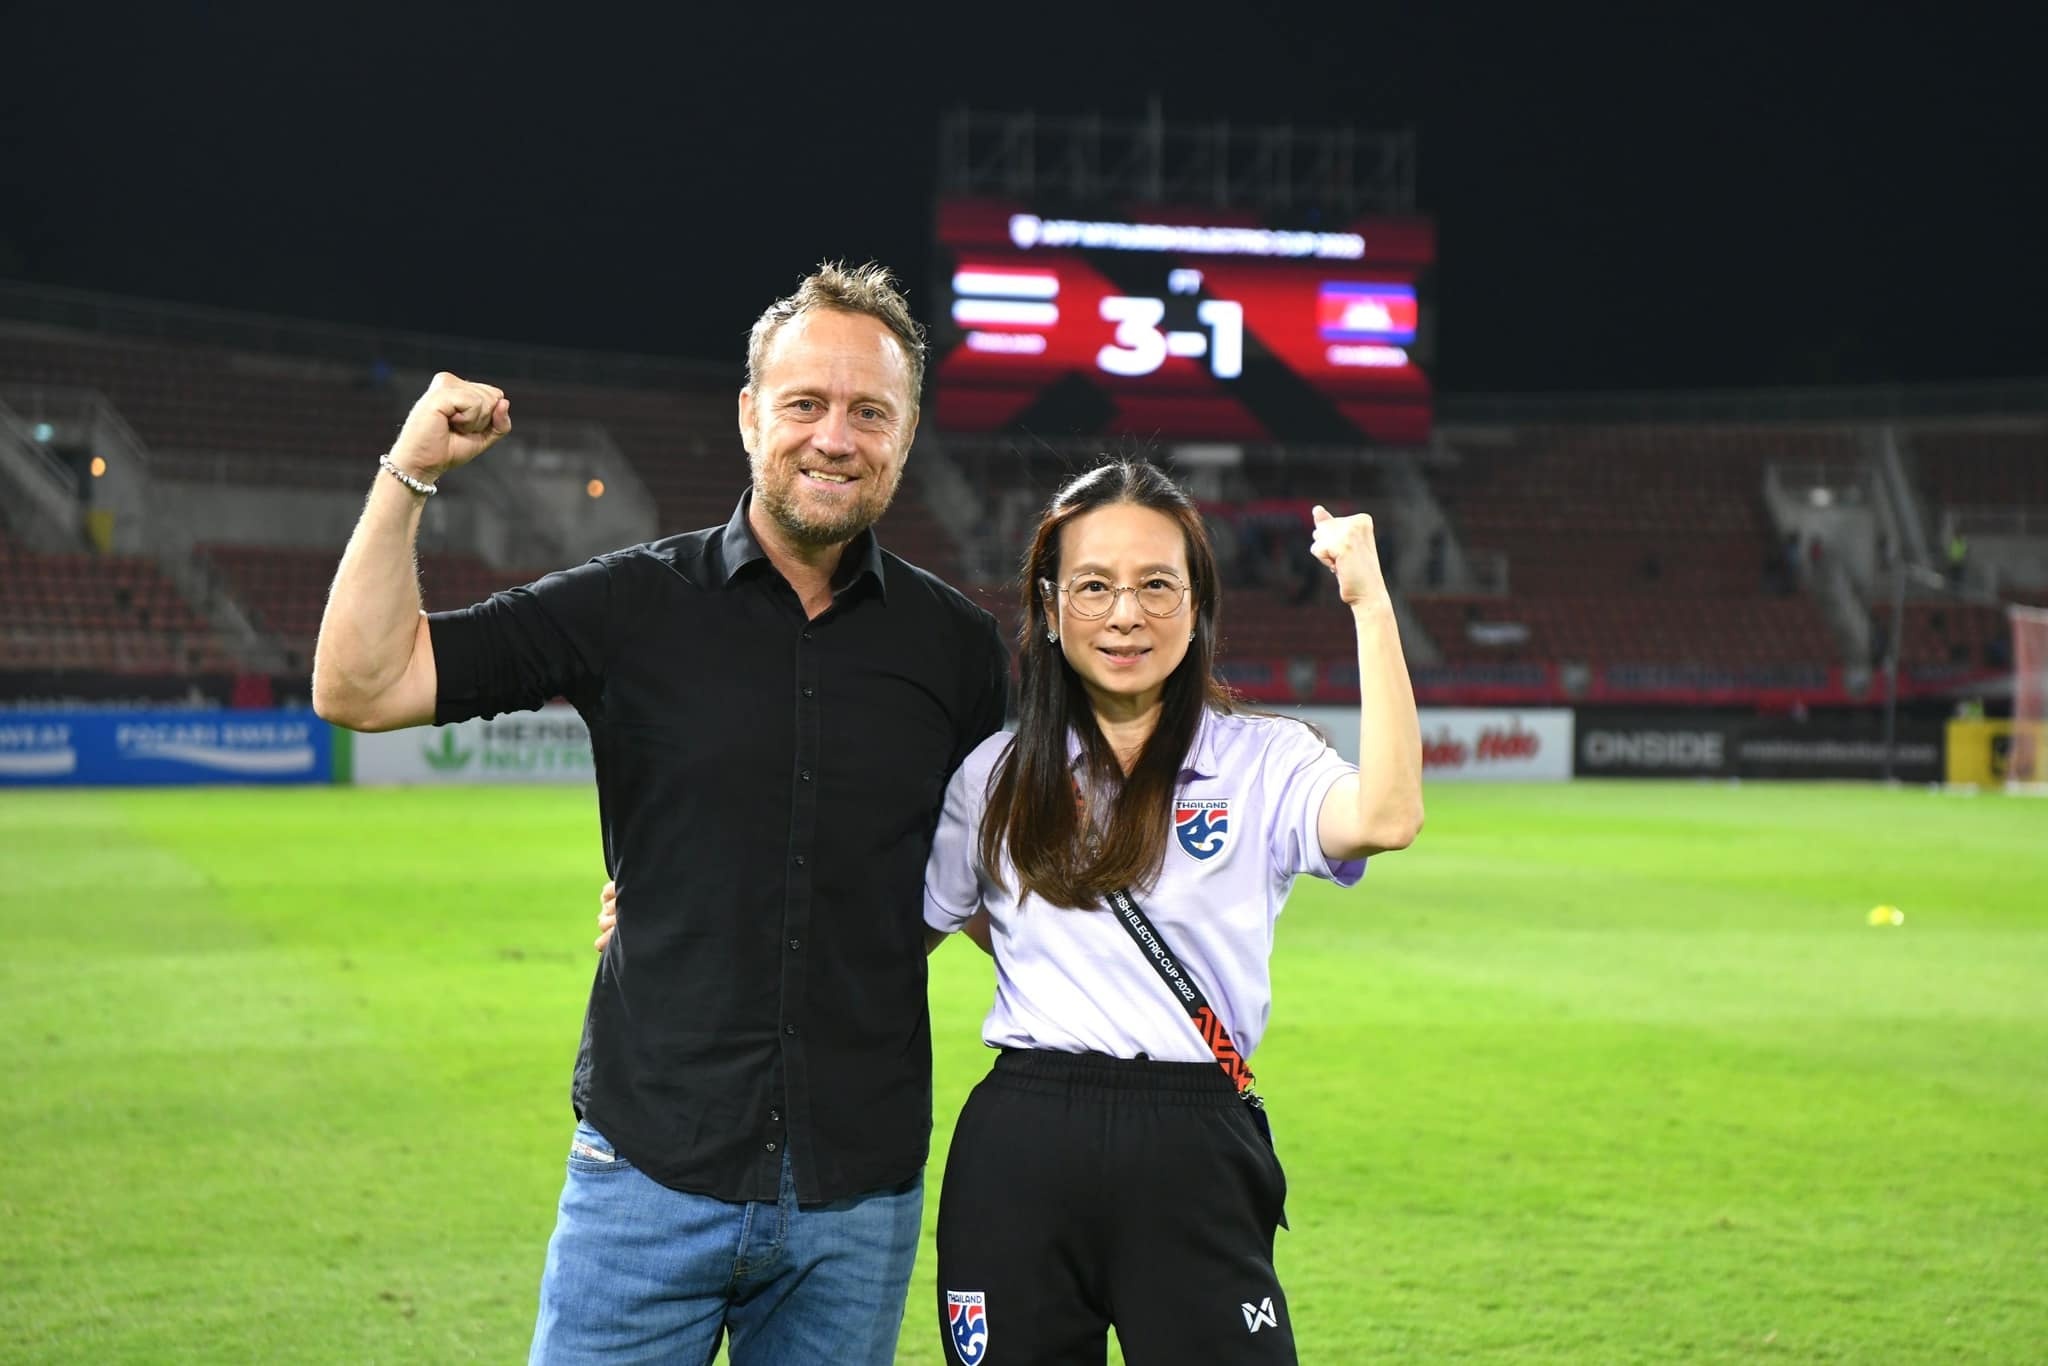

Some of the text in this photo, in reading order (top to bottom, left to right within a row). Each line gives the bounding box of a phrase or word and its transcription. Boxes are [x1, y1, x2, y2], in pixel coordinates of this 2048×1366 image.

[1097, 296, 1243, 379] 3-1
[1585, 730, 1724, 767] ONSIDE
[1176, 801, 1228, 809] THAILAND
[1129, 915, 1165, 959] ELECTRIC
[1160, 958, 1180, 978] CUP
[1174, 977, 1195, 1002] 2022
[948, 1293, 983, 1304] THAILAND
